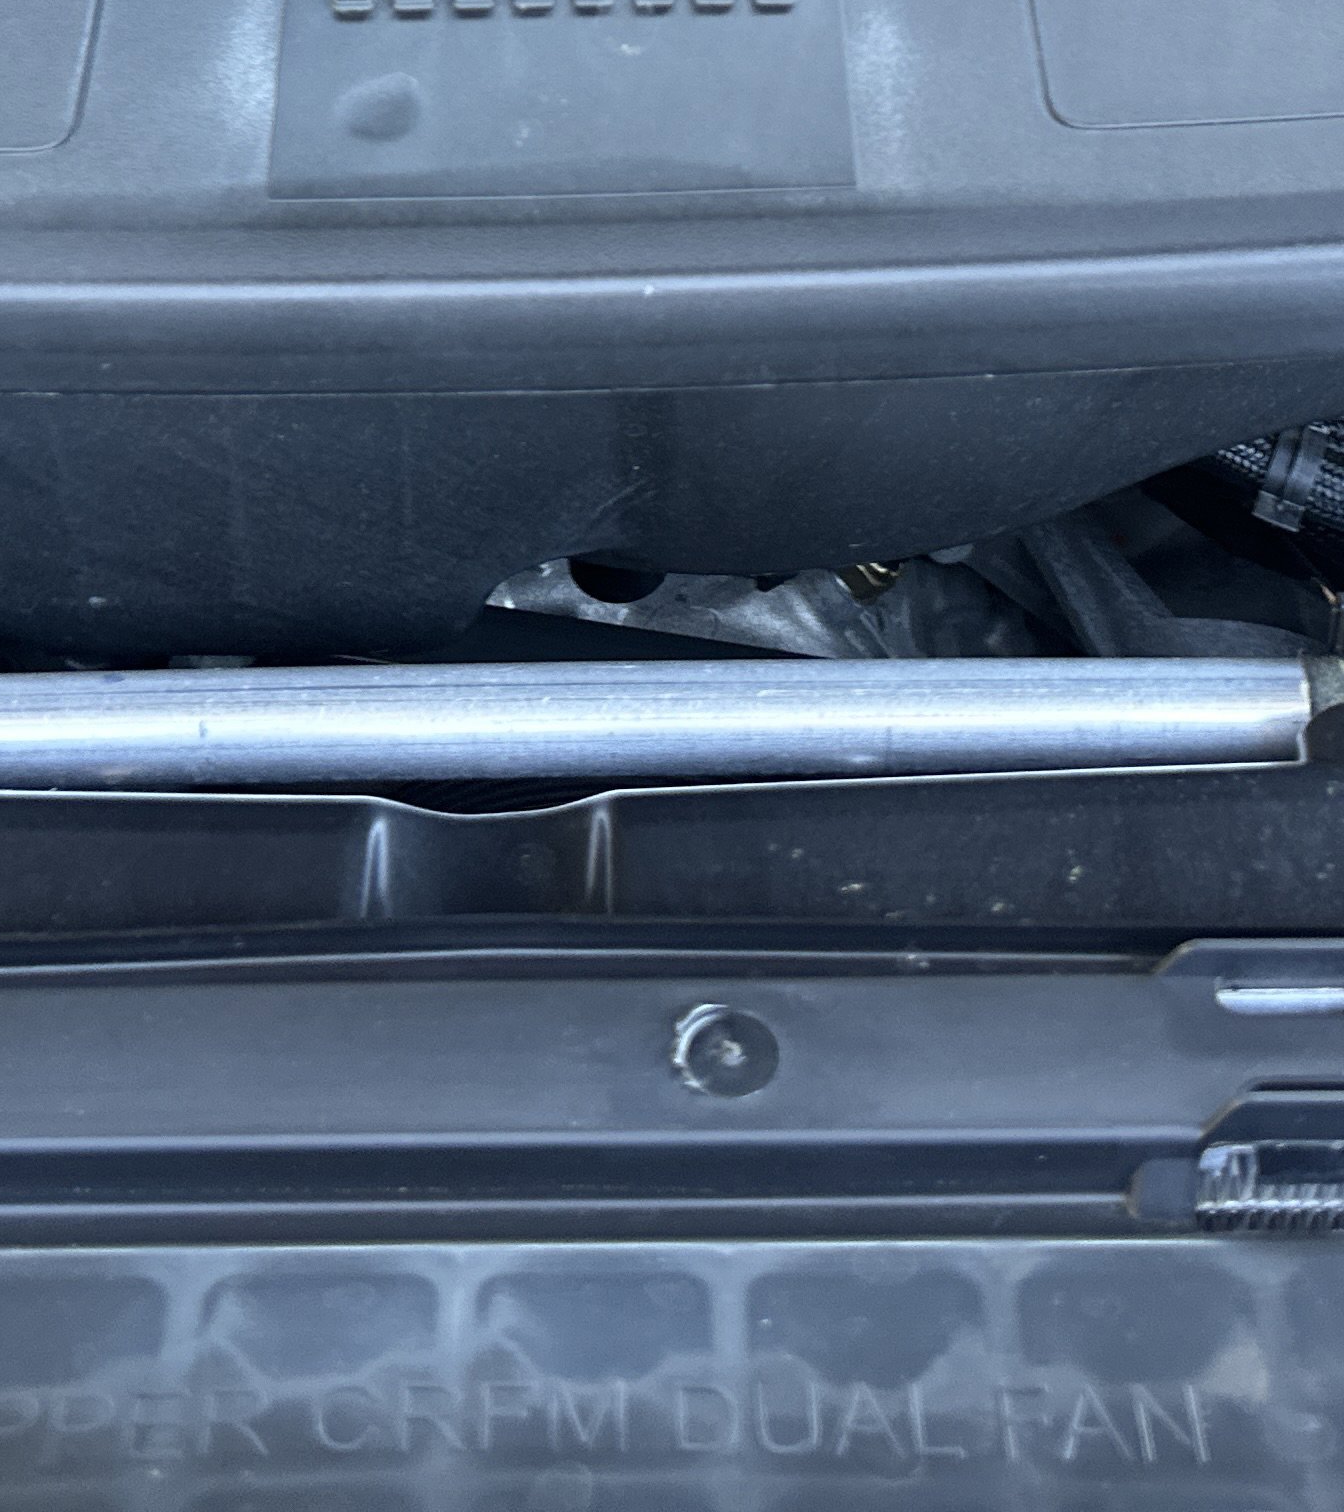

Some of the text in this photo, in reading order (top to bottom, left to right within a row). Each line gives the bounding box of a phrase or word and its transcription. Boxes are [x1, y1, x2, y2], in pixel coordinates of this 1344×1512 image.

[314, 1380, 626, 1450] CRFM
[675, 1381, 965, 1460] DUAL
[1000, 1381, 1211, 1462] FAN
